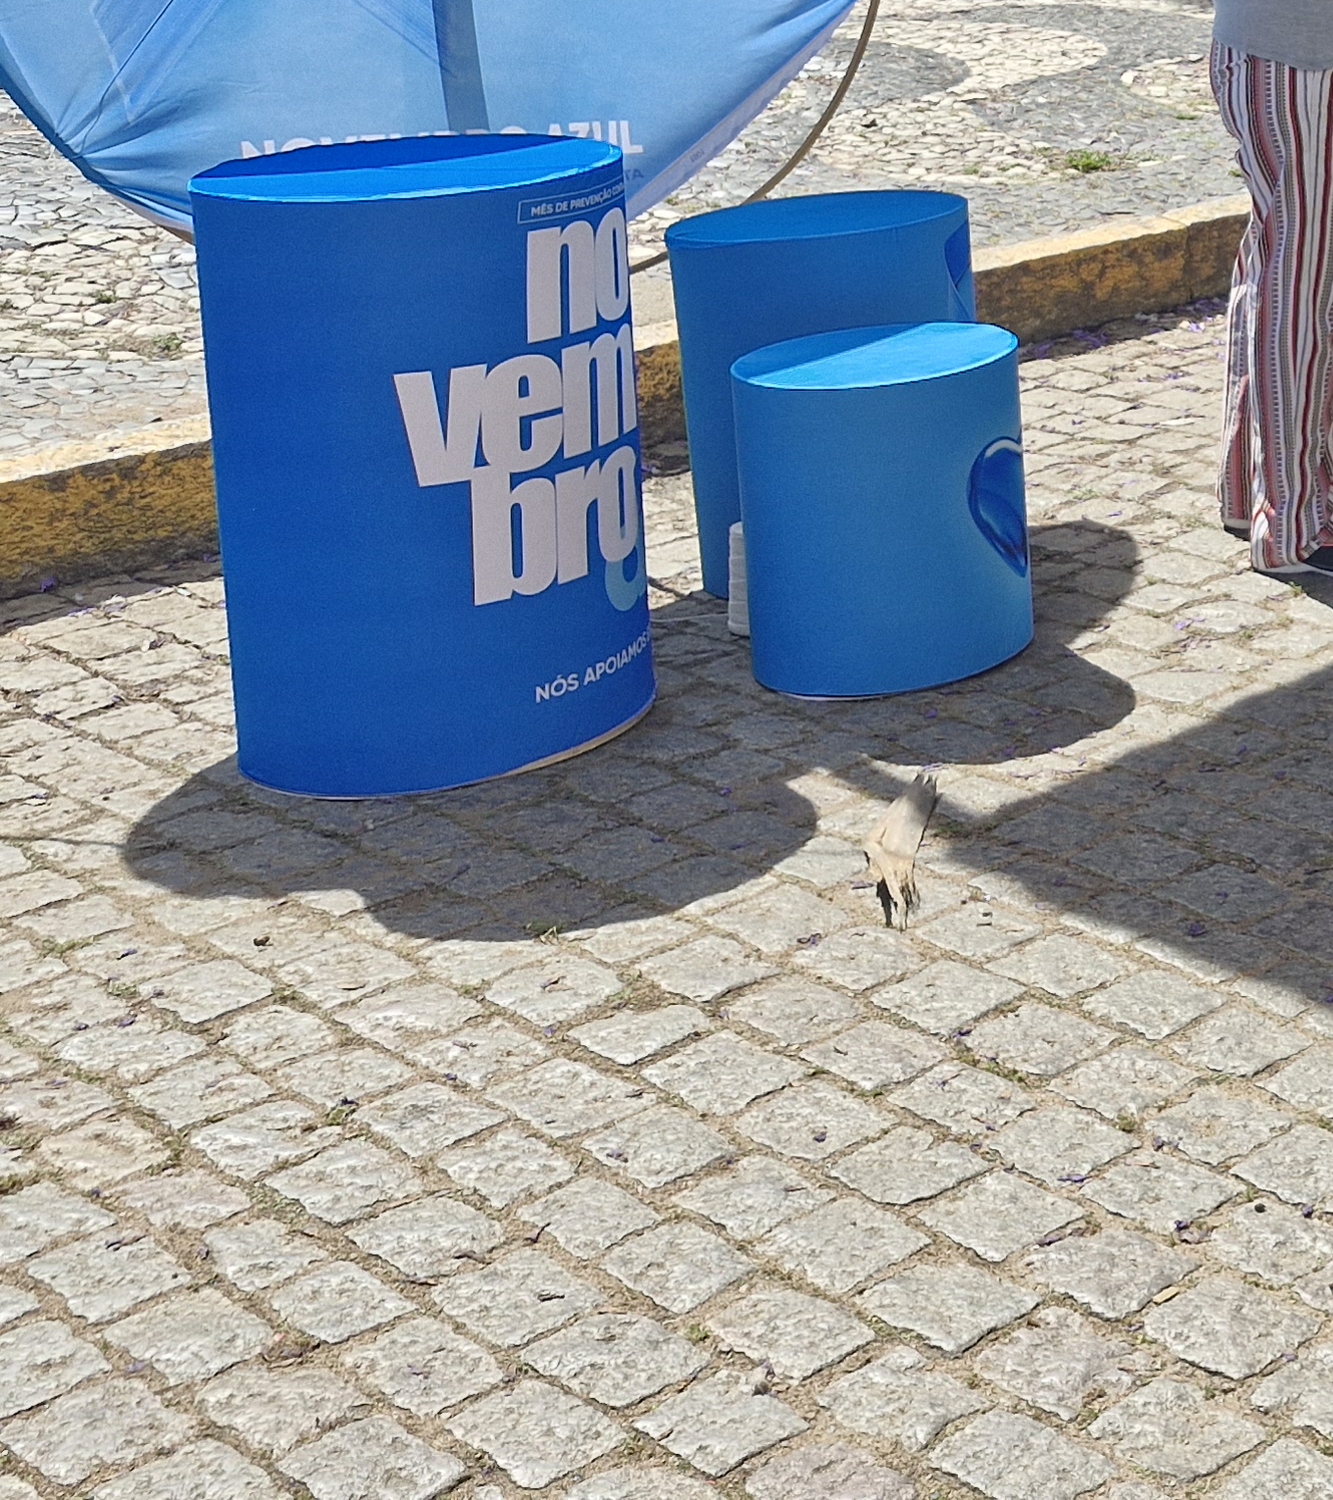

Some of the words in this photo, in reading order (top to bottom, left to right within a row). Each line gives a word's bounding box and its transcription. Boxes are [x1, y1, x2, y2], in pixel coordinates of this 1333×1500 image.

[530, 203, 554, 217] MÊS
[555, 200, 569, 213] DE
[570, 187, 612, 210] PREVENÇÃO
[526, 206, 631, 344] no
[393, 322, 639, 488] vem
[470, 445, 639, 607] bro
[535, 673, 579, 704] NÓS
[583, 631, 647, 686] APOIAMOS
